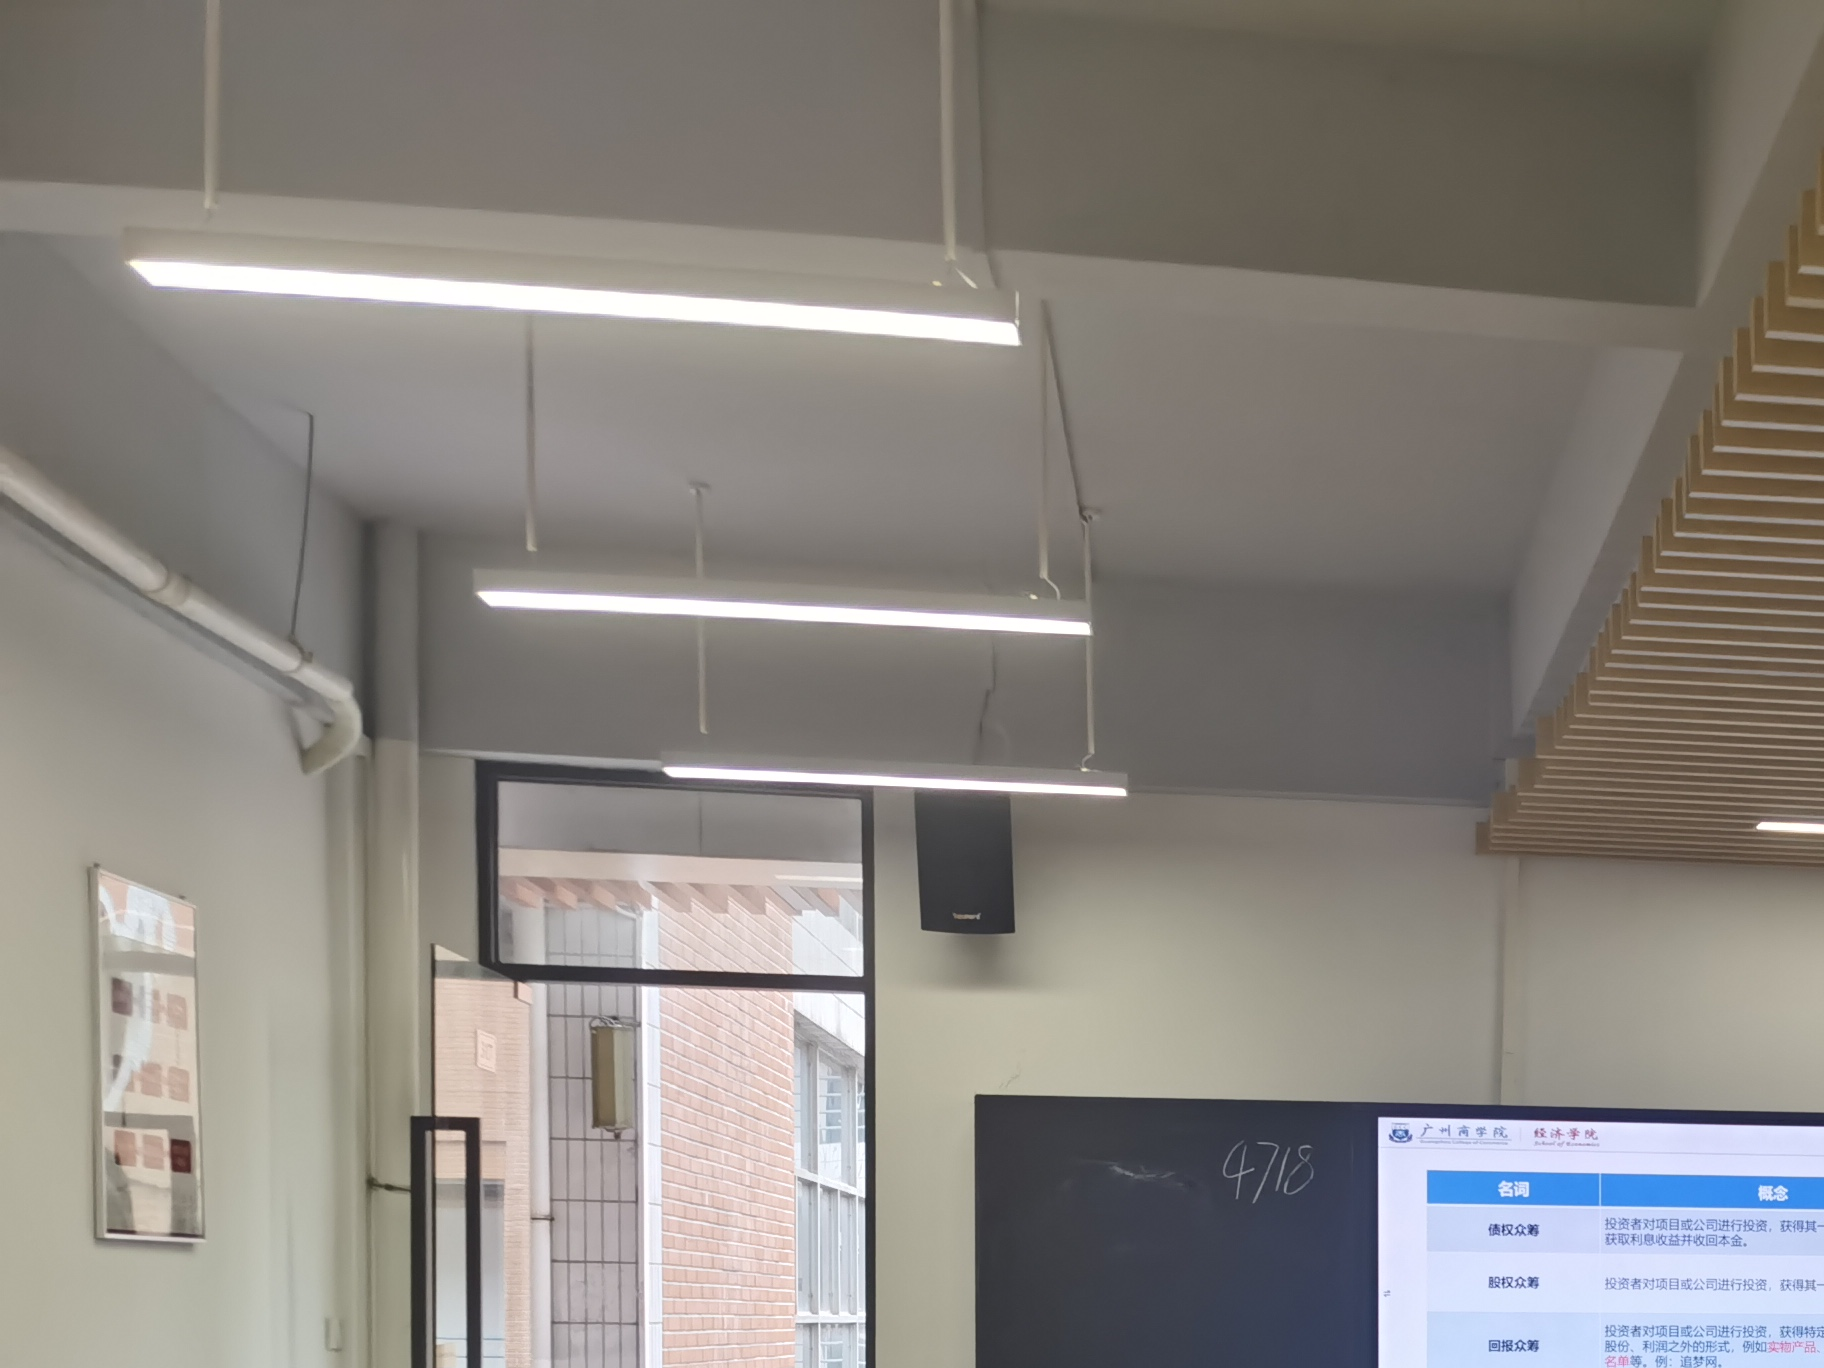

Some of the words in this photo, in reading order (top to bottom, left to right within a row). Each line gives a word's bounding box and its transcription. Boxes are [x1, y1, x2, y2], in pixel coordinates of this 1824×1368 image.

[1420, 1123, 1508, 1138] 广州商学院
[1223, 1140, 1314, 1204] 4718
[1497, 1181, 1530, 1198] 名词
[1757, 1185, 1789, 1202] 概念
[1488, 1223, 1540, 1237] 债权众筹
[1604, 1232, 1748, 1248] 获取利息收益并收回本金。
[1488, 1276, 1540, 1289] 股权众筹
[1488, 1339, 1540, 1353] 回报众筹
